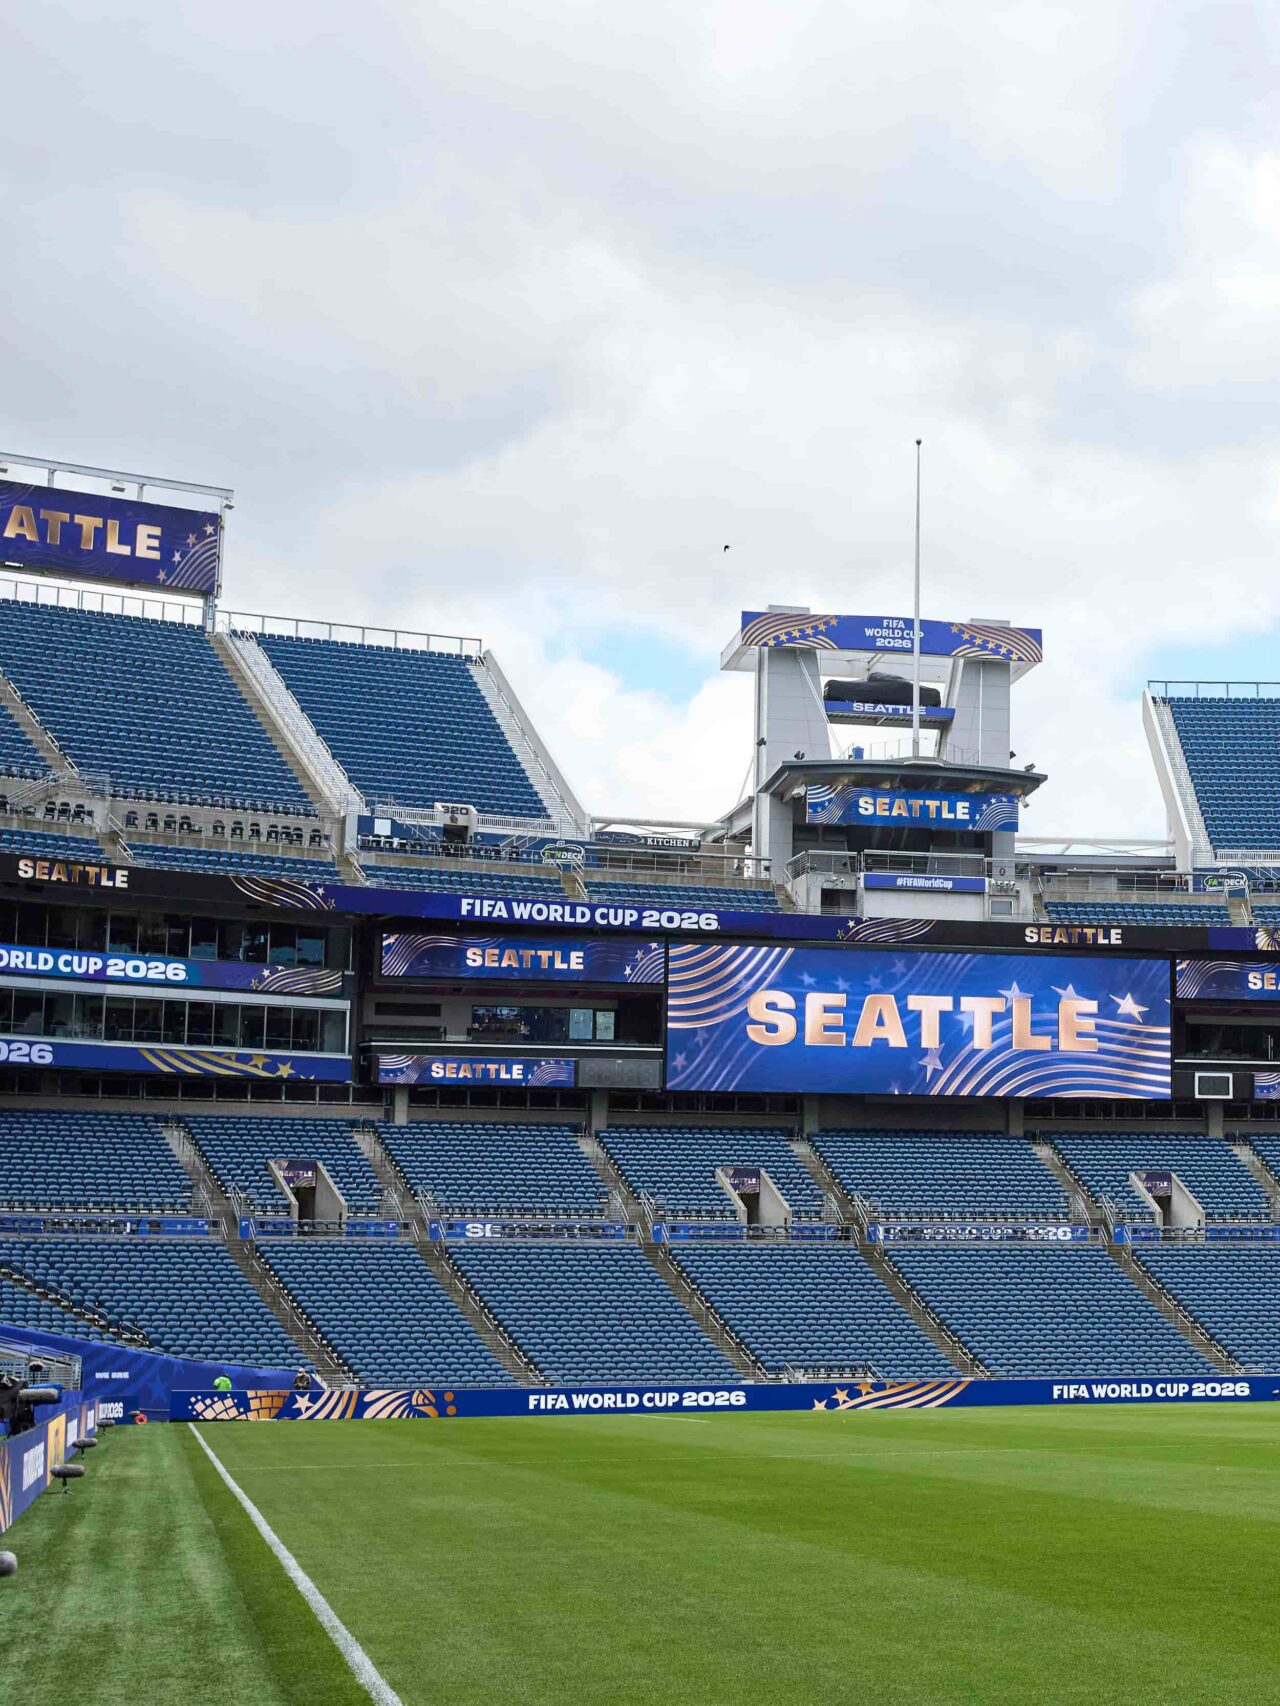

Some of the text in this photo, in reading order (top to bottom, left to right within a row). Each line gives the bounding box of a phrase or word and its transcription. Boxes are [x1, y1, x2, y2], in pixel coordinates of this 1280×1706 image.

[3, 505, 162, 560] ATTLE
[865, 628, 902, 638] WORLD
[883, 619, 905, 629] FIFA
[876, 638, 912, 648] 2026
[442, 805, 469, 816] 320
[858, 796, 970, 820] SEATTLE
[646, 837, 690, 847] KITCHEN
[18, 858, 129, 888] SEATTLE
[896, 877, 953, 889] #FIFAWorldCup
[461, 898, 719, 930] FIFA WORLD CUP 2026
[1025, 927, 1122, 944] SEATTLE
[58, 954, 103, 975] CUP
[106, 958, 187, 981] 2026
[466, 947, 584, 970] SEATTLE
[746, 989, 1100, 1052] SEATTLE
[0, 1042, 53, 1065] 26
[431, 1061, 524, 1079] SEATTLE
[529, 1390, 746, 1410] FIFA WORLD CUP 2026
[1053, 1382, 1250, 1399] FIFA WORLD CUP 2026
